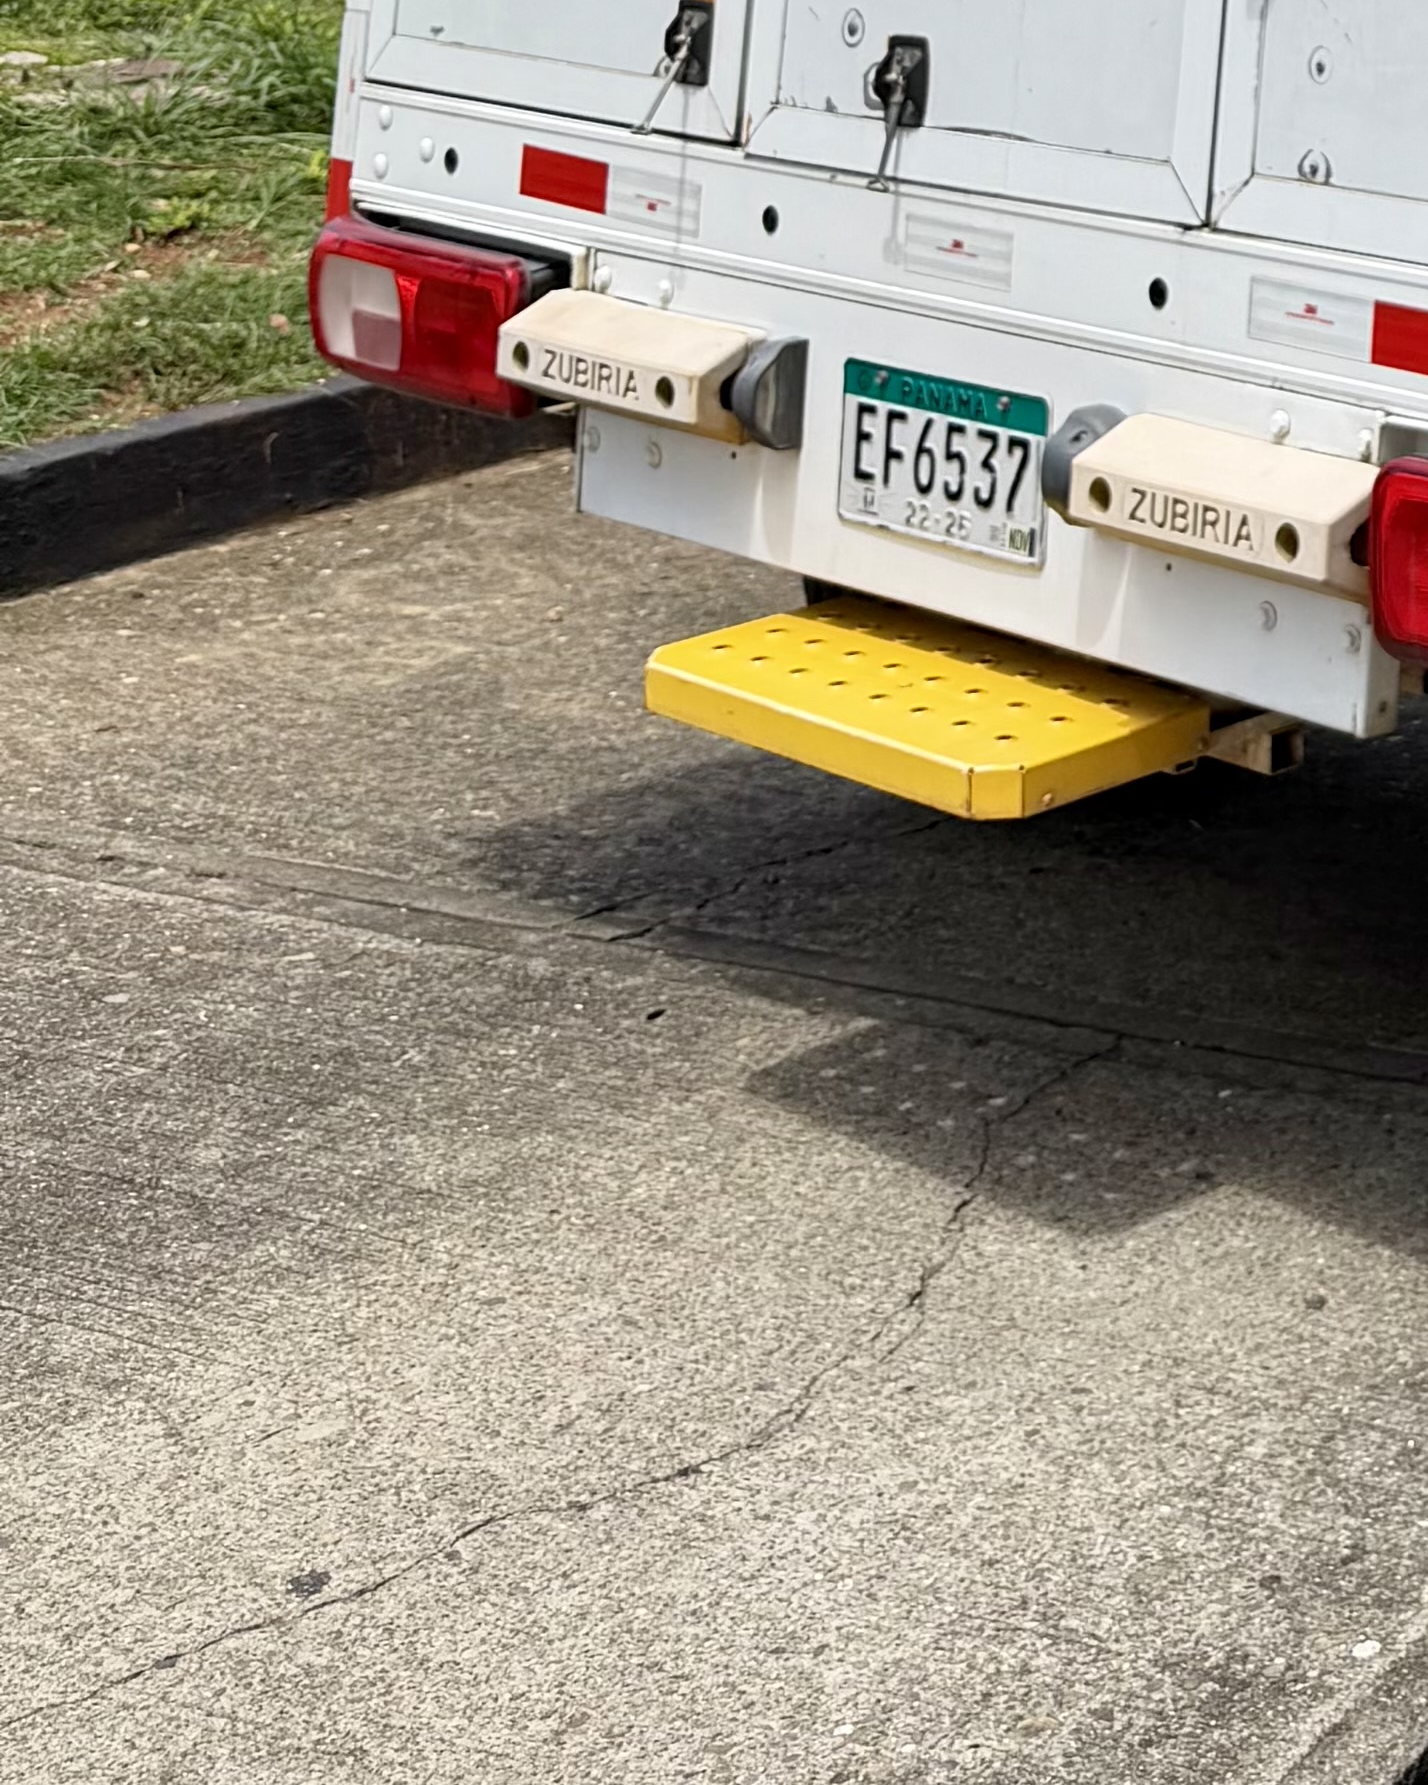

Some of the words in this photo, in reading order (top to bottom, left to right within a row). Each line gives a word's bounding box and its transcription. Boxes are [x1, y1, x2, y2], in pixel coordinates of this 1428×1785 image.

[542, 347, 640, 402] ZUBIRIA
[901, 375, 988, 420] PANAMA
[853, 400, 1032, 515] EF6537
[1127, 486, 1255, 552] ZUBIRIA
